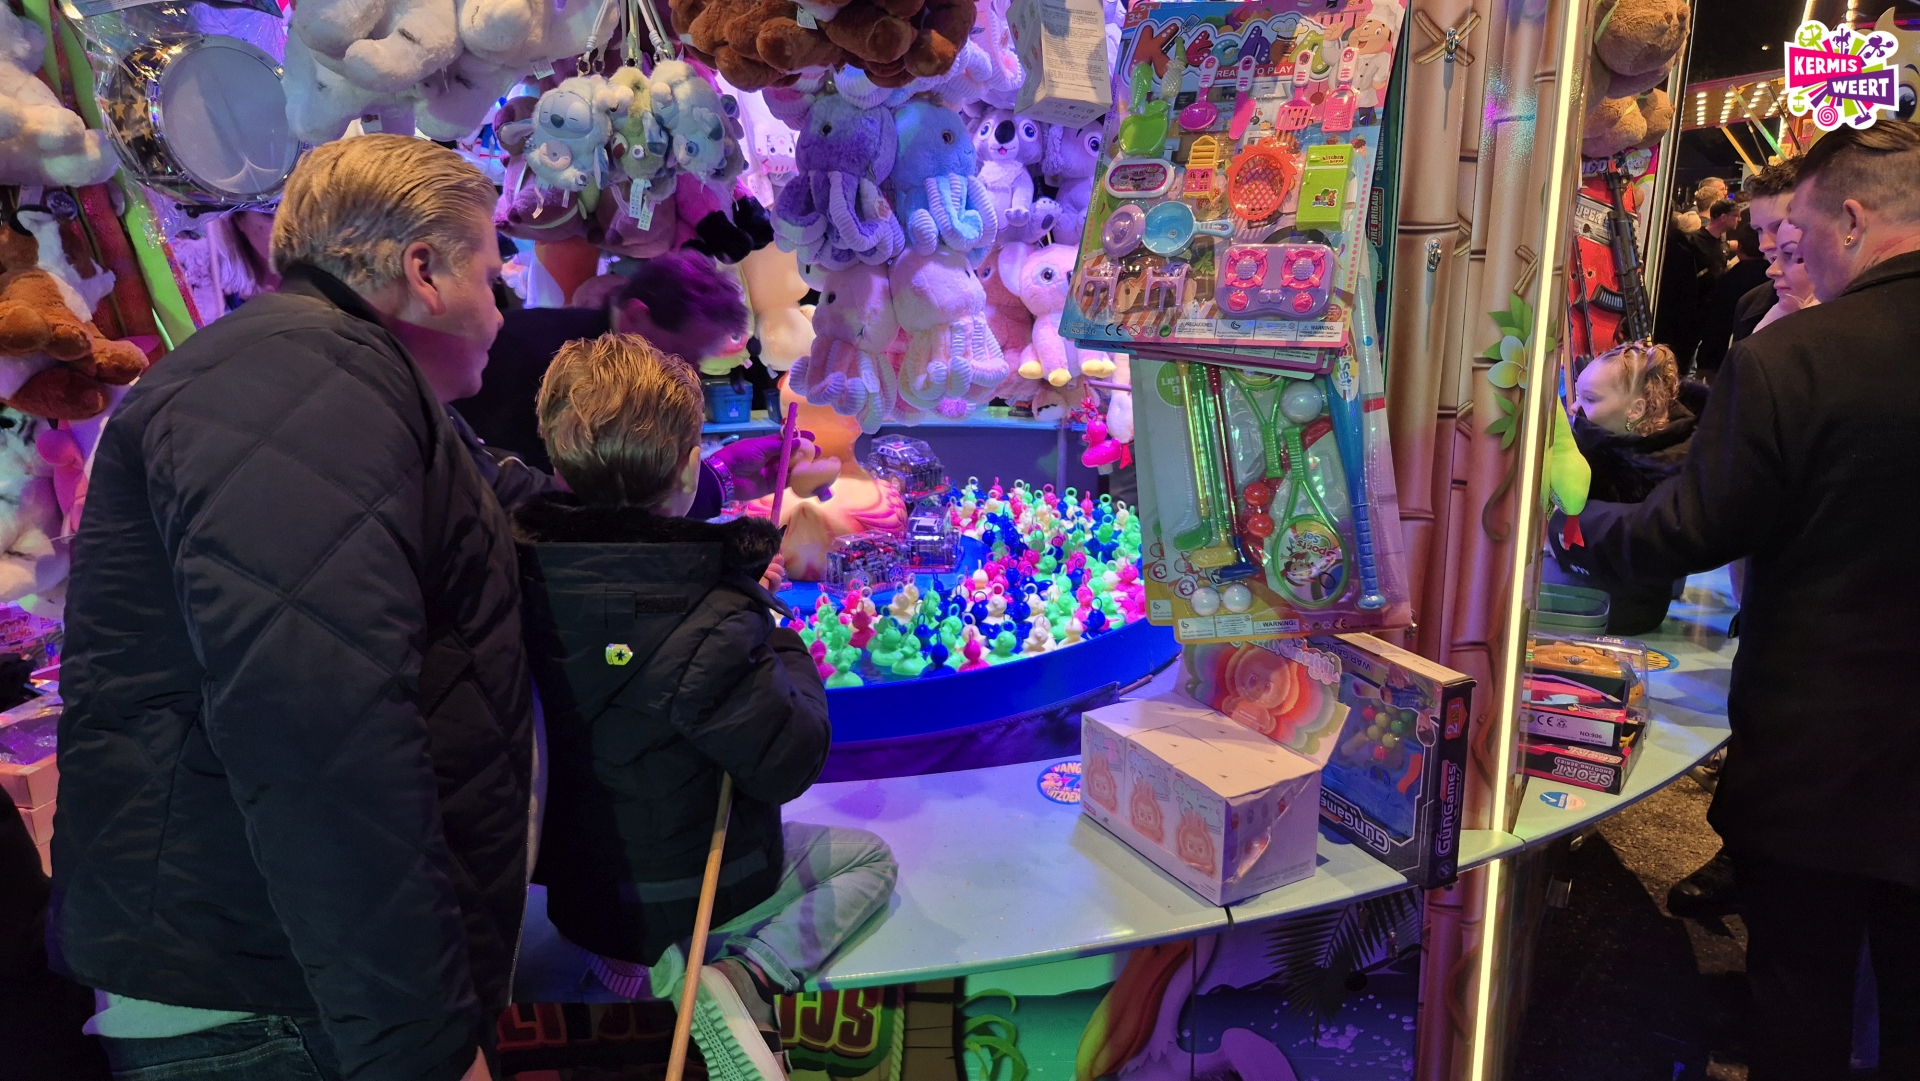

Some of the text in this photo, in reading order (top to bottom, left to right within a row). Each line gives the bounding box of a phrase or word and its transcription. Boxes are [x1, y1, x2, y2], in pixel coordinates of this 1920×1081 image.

[1127, 13, 1142, 24] 3+
[1267, 65, 1293, 74] PLAY
[1371, 191, 1379, 225] BRIGADE
[1324, 641, 1371, 672] WAR GAME
[1446, 723, 1458, 734] 2
[1054, 762, 1081, 774] VANG
[1553, 764, 1612, 787] SPORT
